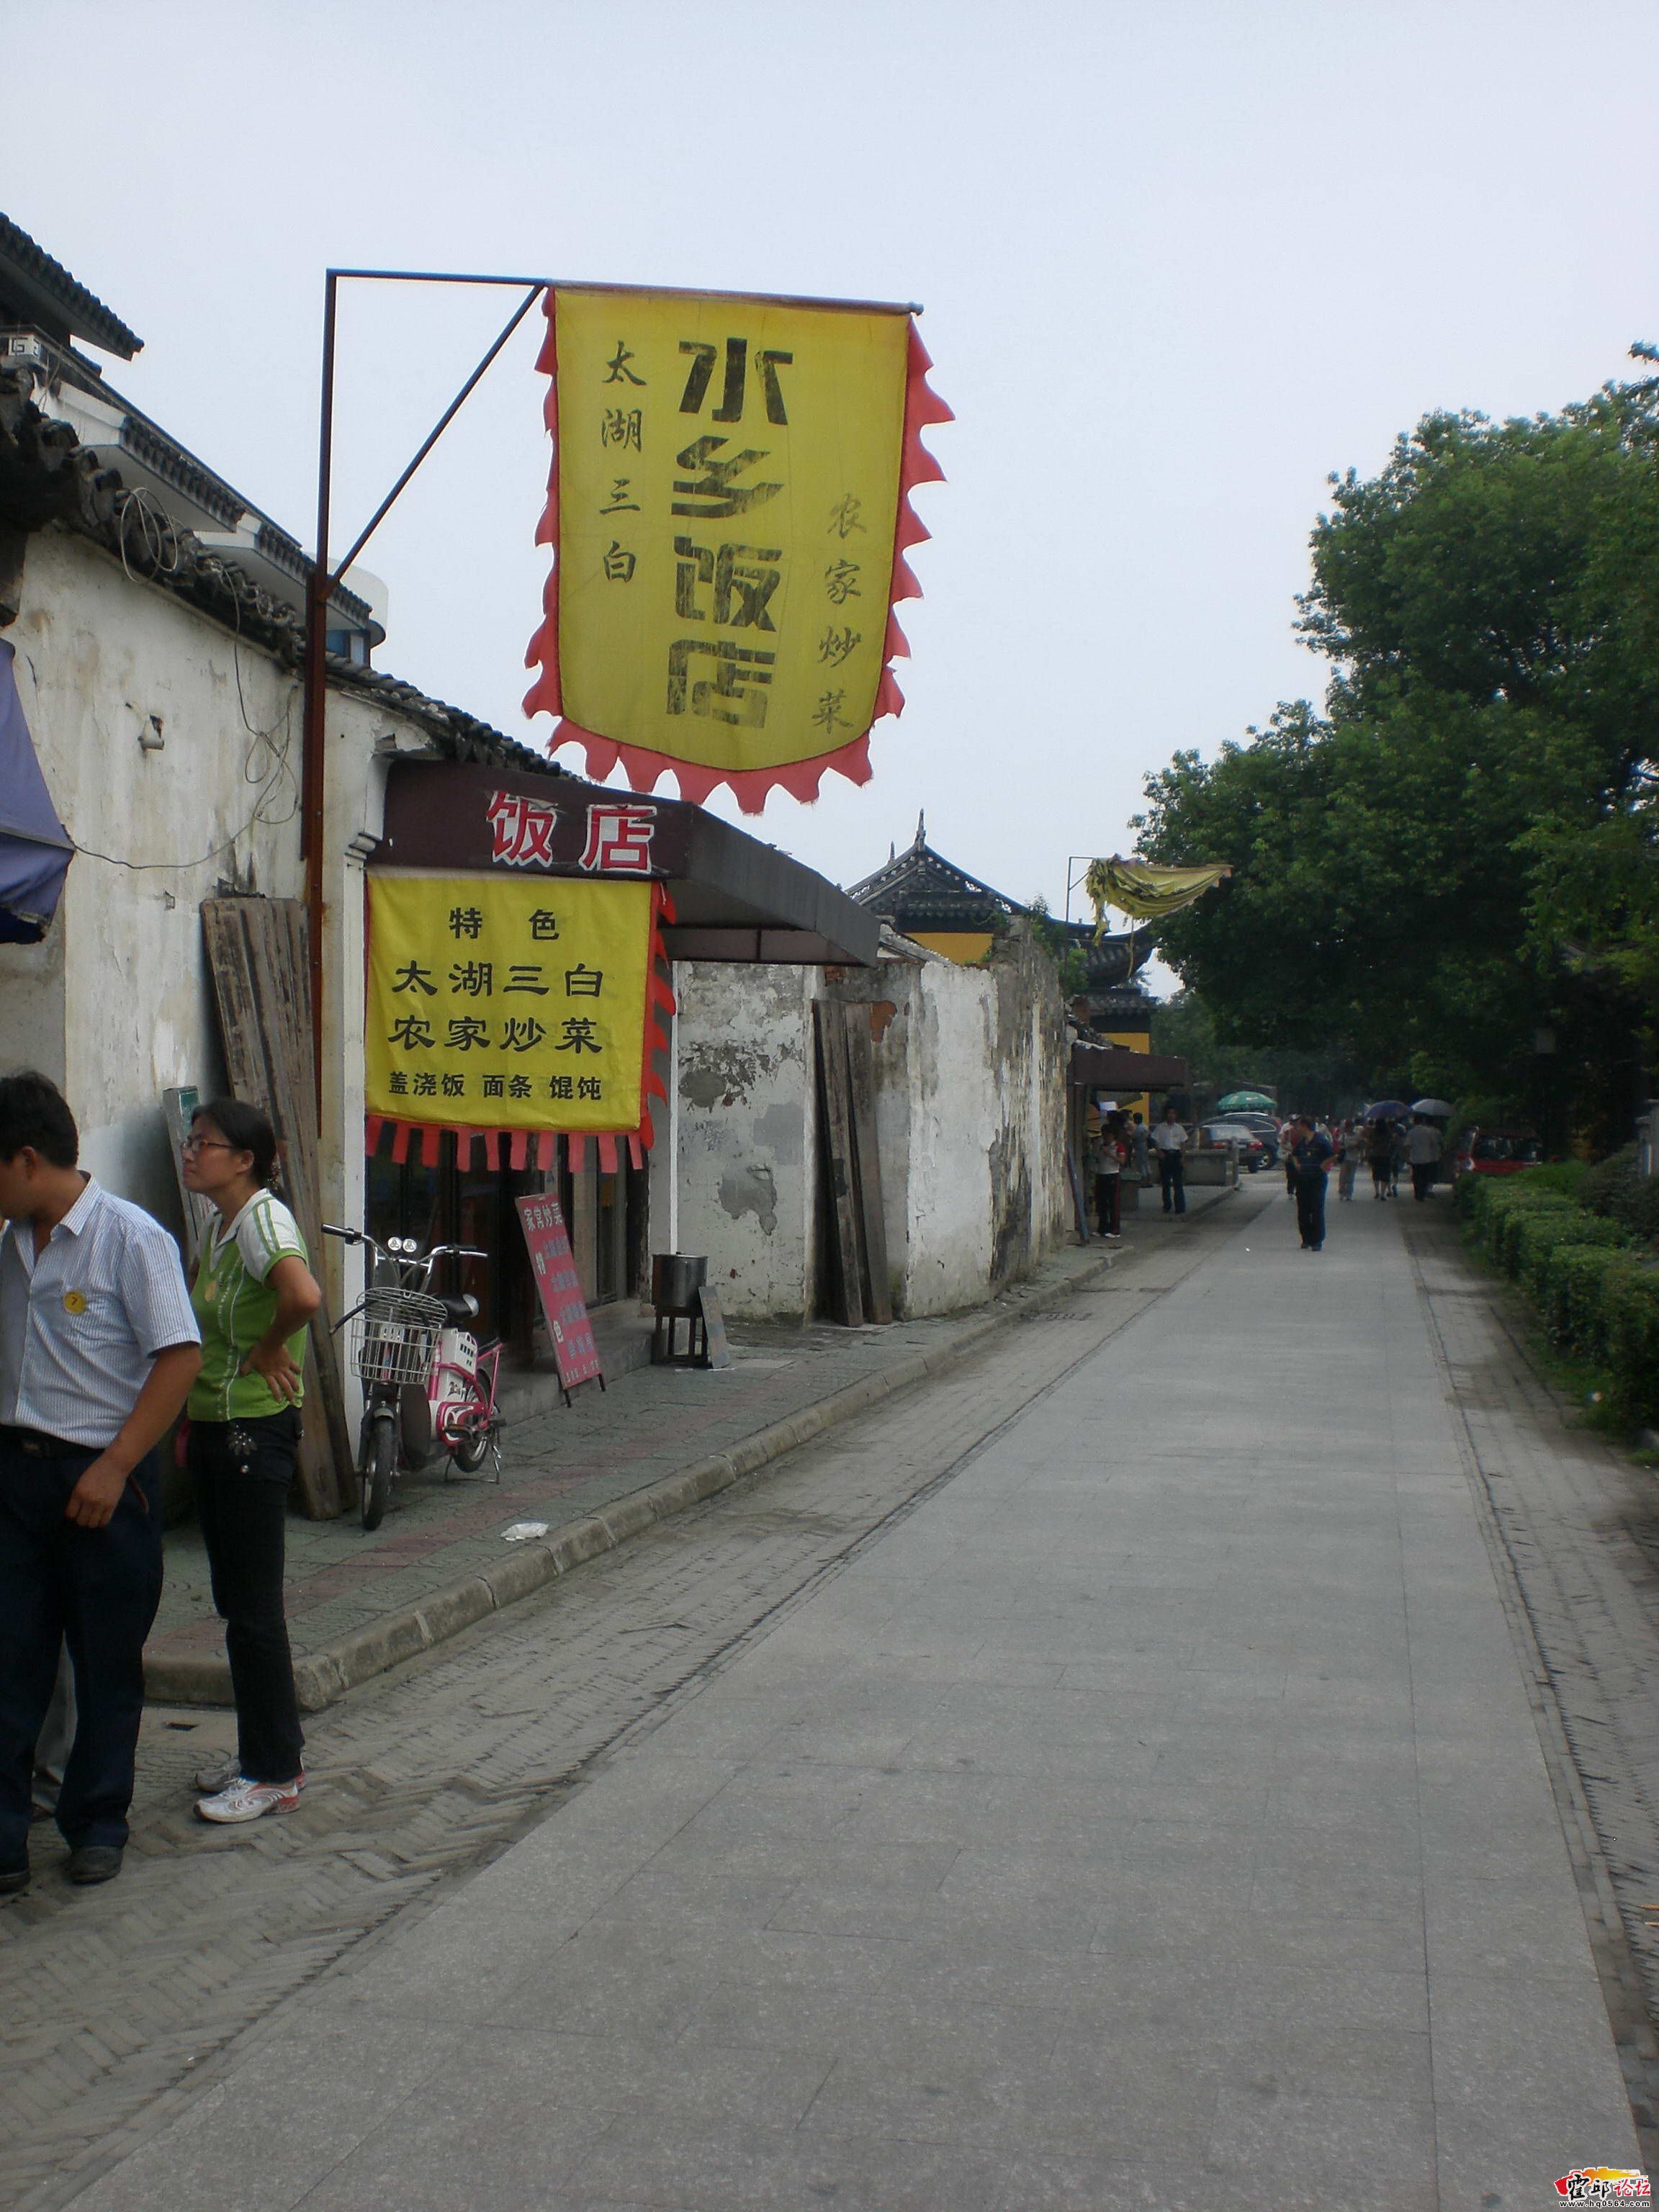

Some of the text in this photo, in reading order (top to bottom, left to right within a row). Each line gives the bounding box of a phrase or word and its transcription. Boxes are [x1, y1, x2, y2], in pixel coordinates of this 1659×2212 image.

[600, 341, 647, 583] 太湖三白
[665, 337, 793, 728] 水乡饭店
[811, 493, 868, 734] 农家炒菜
[487, 791, 657, 872] 饭店
[449, 908, 559, 940] 特色
[392, 960, 603, 997] 太湖三白
[387, 1015, 603, 1053] 农家炒菜
[389, 1072, 602, 1101] 盖浇饭 面条 馄饨
